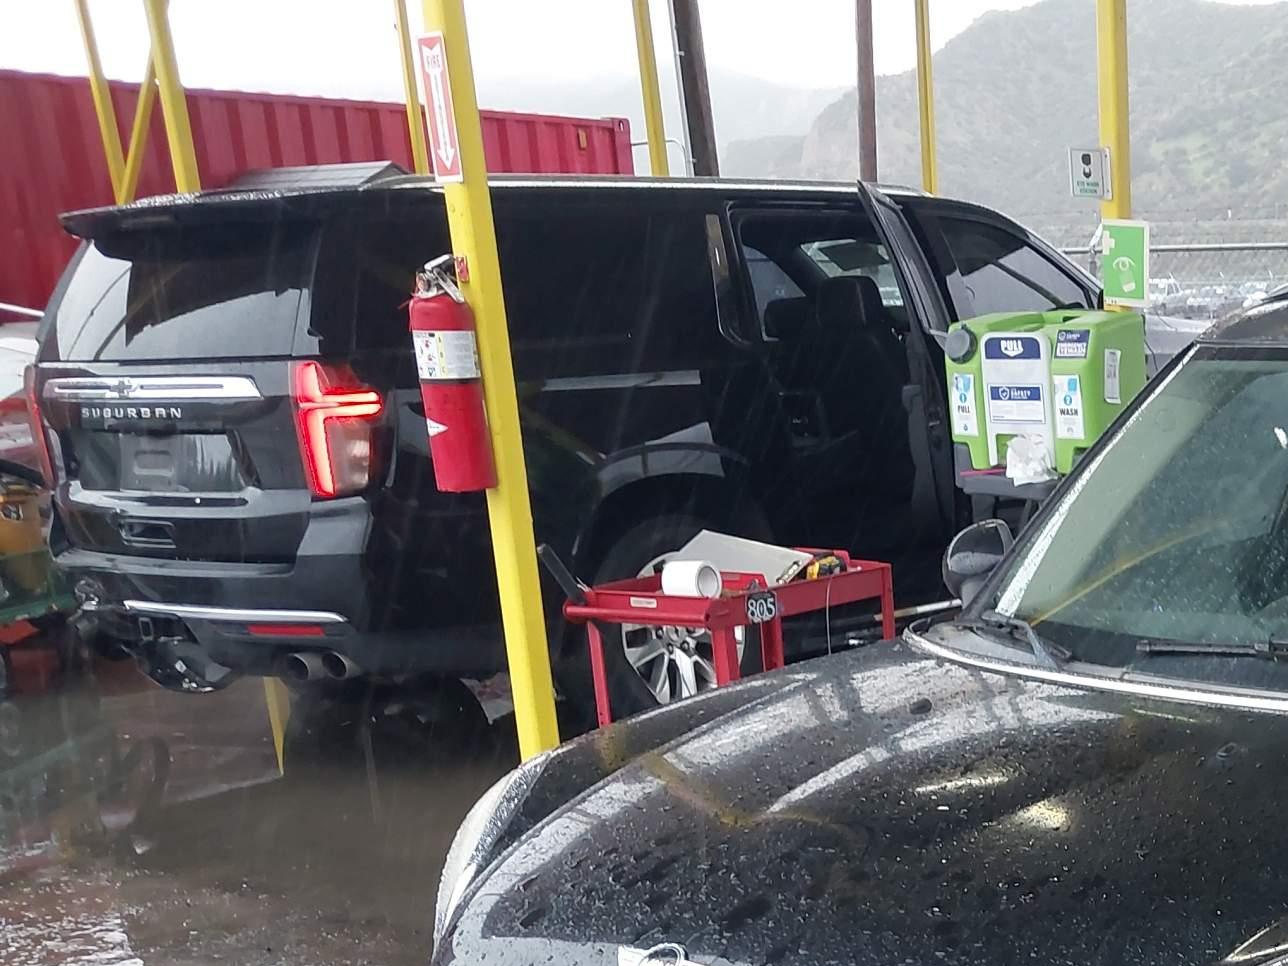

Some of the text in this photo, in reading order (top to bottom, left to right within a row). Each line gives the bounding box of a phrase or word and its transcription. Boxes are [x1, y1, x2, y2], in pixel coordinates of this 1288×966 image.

[1001, 339, 1023, 352] PULL
[81, 407, 182, 419] SUBURBAN
[1059, 408, 1079, 417] WASH
[747, 597, 776, 619] 805
